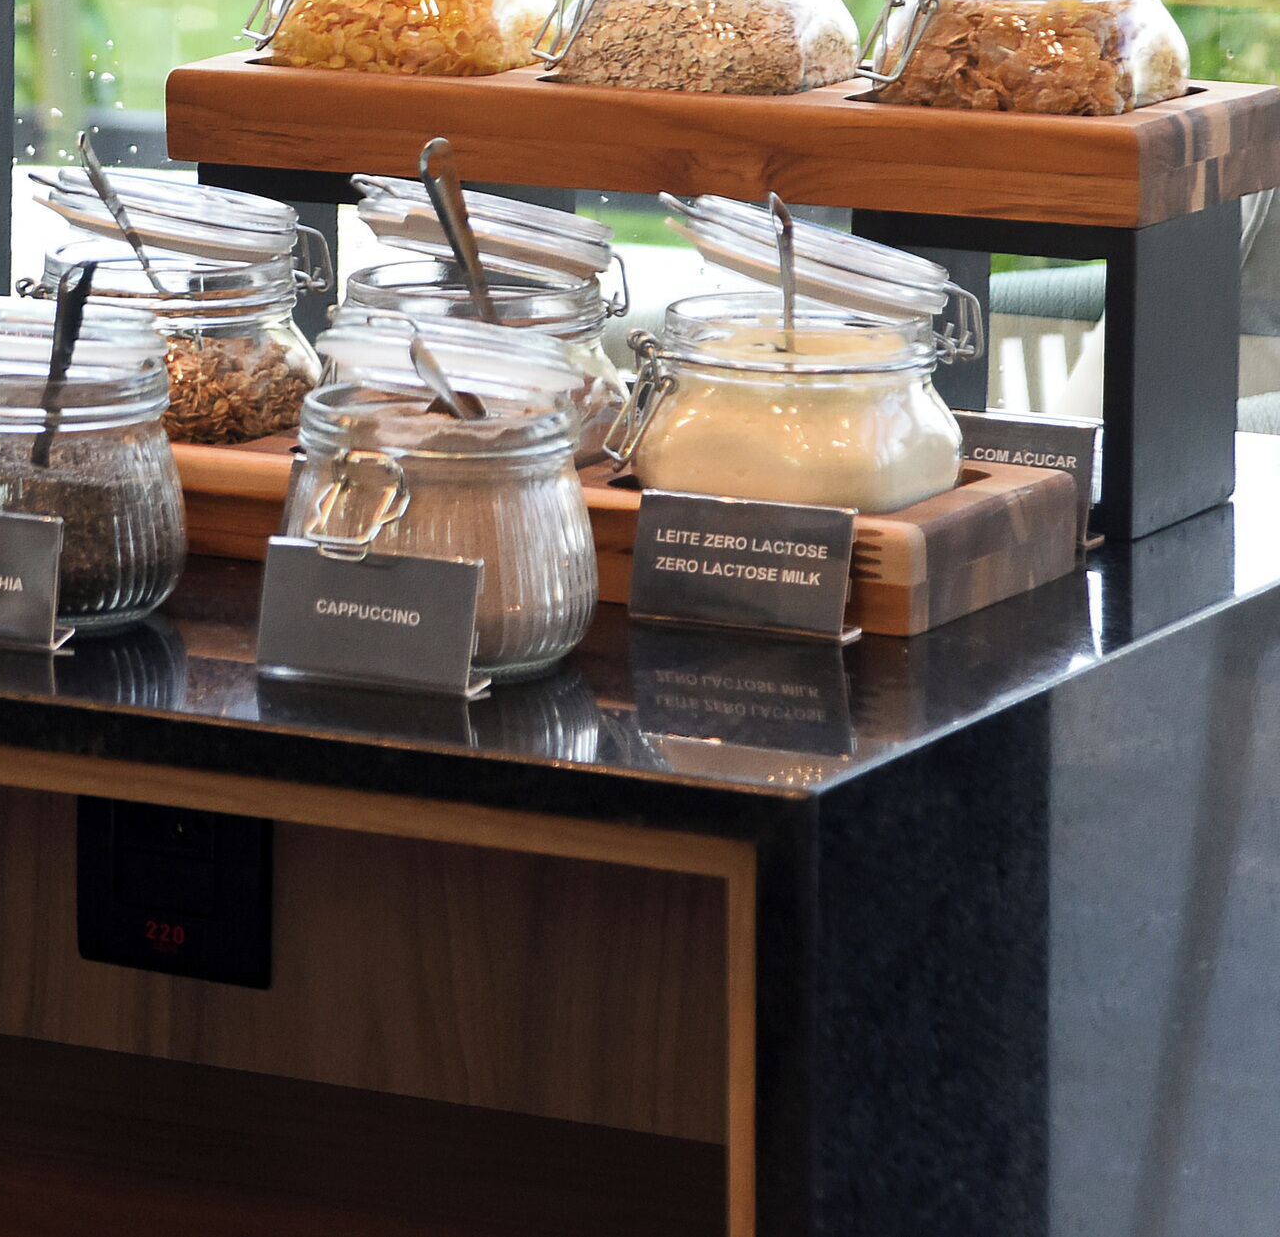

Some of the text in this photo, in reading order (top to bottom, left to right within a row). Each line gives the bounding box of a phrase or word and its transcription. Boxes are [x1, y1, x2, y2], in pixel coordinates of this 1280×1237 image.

[973, 447, 1009, 462] COM
[656, 528, 828, 559] LEITE ZERO LACTOSE
[655, 556, 821, 586] ZERO LACTOSE MILK
[316, 598, 421, 627] CAPPUCCINO
[145, 921, 186, 945] 220
